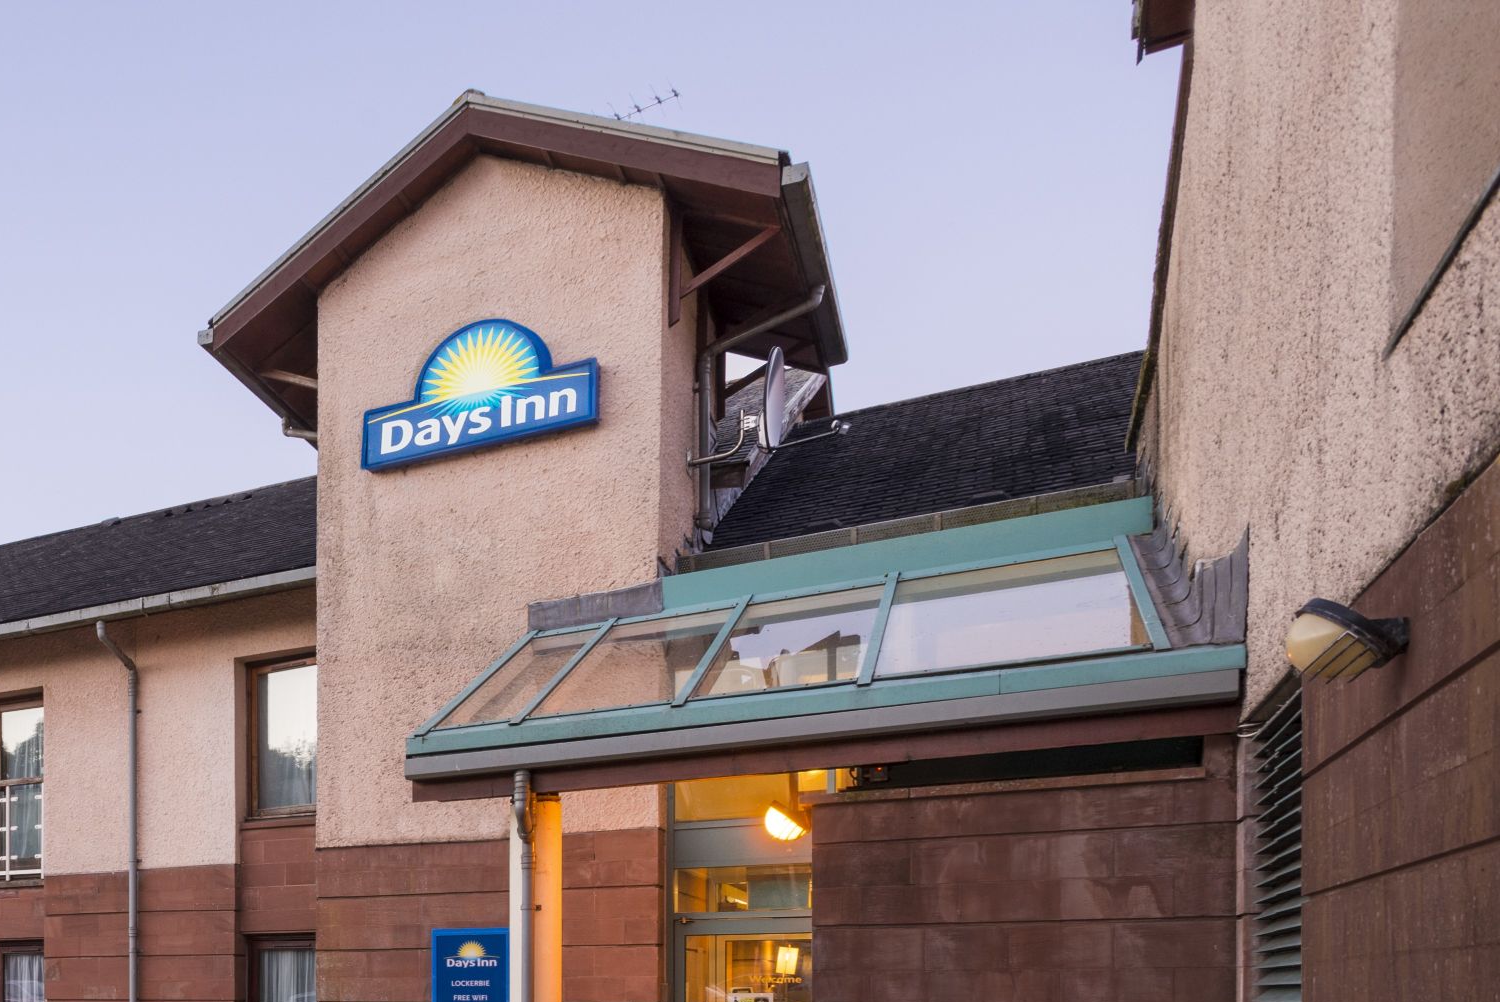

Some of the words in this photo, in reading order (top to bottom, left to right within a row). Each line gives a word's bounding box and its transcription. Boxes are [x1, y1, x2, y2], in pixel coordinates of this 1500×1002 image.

[381, 406, 492, 455] Days
[500, 387, 577, 428] Inn
[446, 958, 475, 968] Days
[477, 958, 498, 967] Inn
